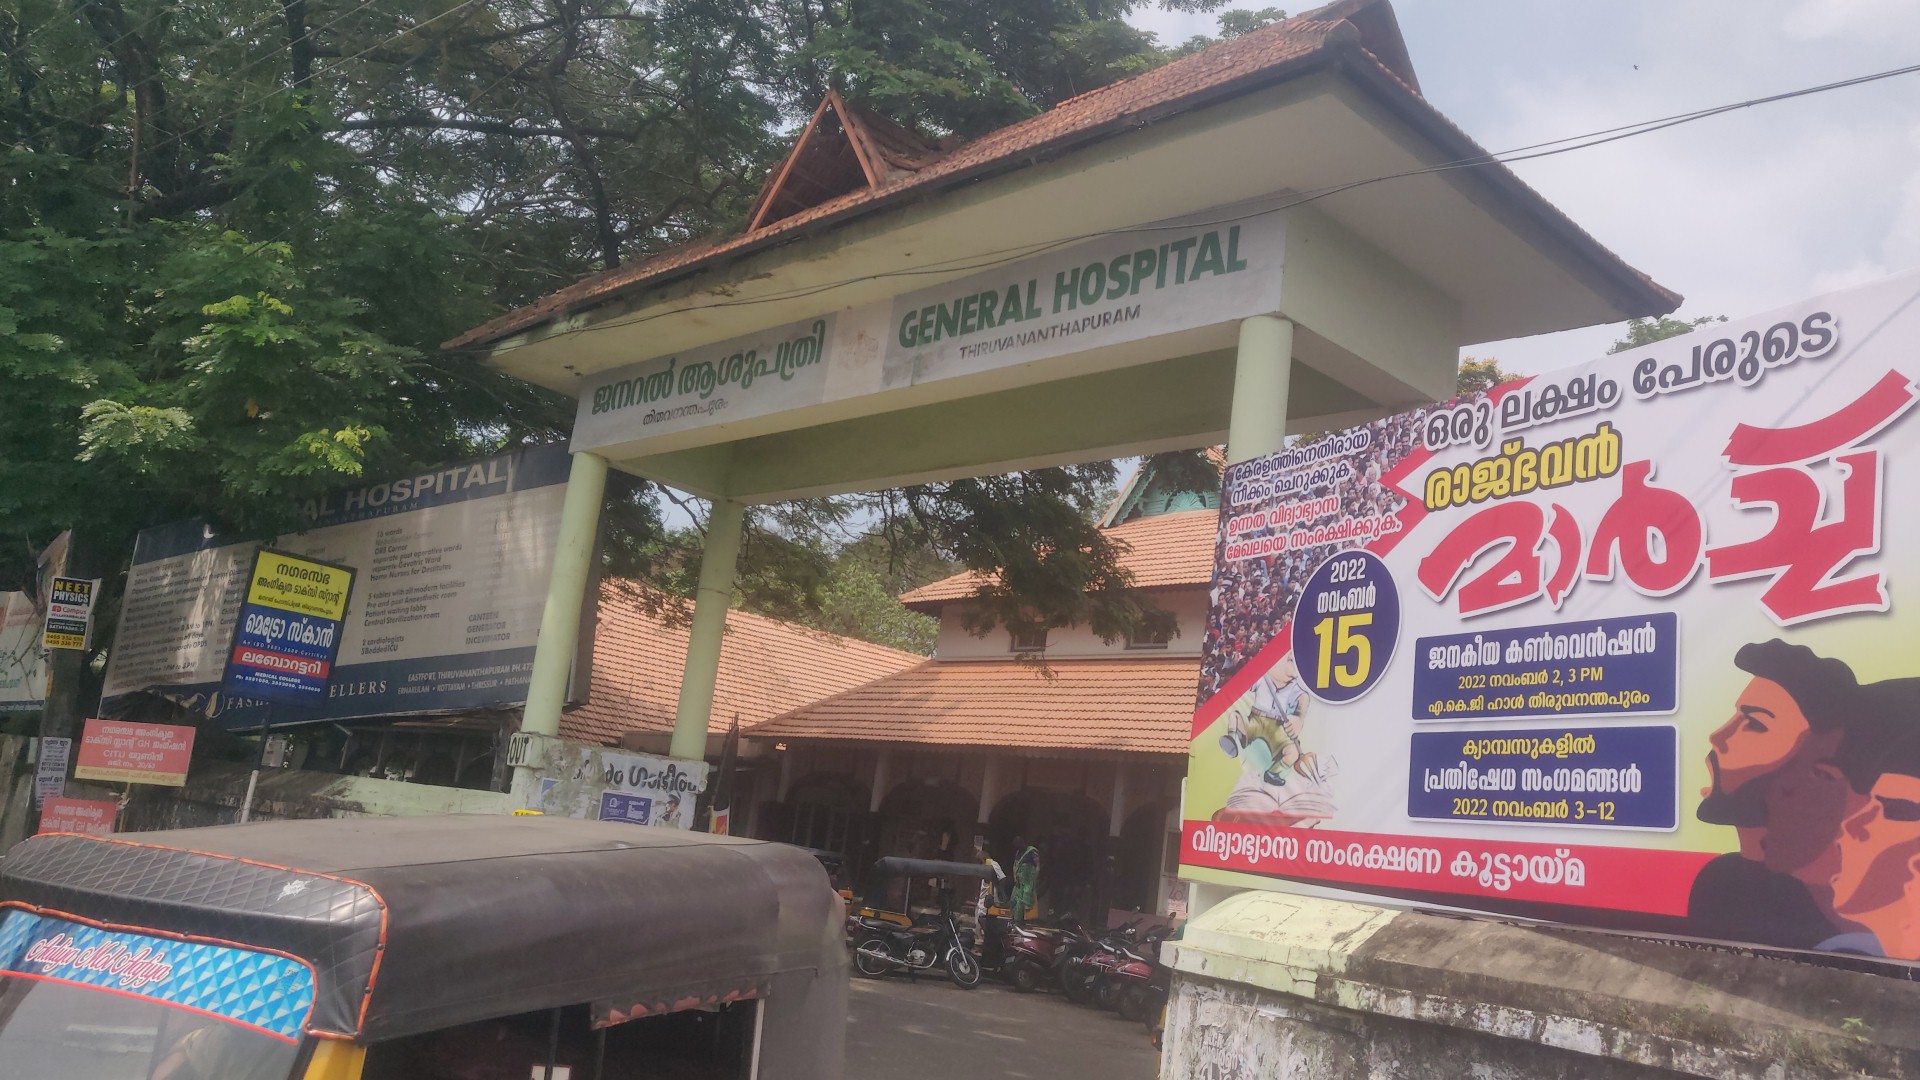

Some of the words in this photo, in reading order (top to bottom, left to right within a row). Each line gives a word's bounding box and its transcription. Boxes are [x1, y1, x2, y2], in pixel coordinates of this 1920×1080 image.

[899, 278, 1042, 349] GENERAL
[1052, 225, 1248, 314] HOSPITAL
[960, 304, 1141, 360] THIRUVANANTHAPURAM
[591, 357, 676, 415] ജനറൽ
[678, 319, 826, 400] ആശുപത്രി
[1427, 400, 1490, 446] ഒരു
[1501, 373, 1618, 429] ലക്ഷം
[1632, 311, 1834, 393] പേരുടെ
[1236, 431, 1369, 481] കേരളത്തിനെതിരായ
[1426, 423, 1621, 510] രാജ്ഭവൻ
[345, 456, 507, 511] HOSPITAL
[1232, 485, 1271, 505] നീക്കം
[1274, 463, 1350, 495] ചെറുക്കുക
[1418, 368, 1911, 621] മാർച്ച്
[1229, 514, 1266, 537] ഉന്നത
[1270, 497, 1340, 527] വിദ്യാഭ്യാസ
[1227, 536, 1287, 560] മേഖലയെ
[1291, 515, 1402, 548] സംരക്ഷിക്കുക.
[276, 563, 330, 585] നഗരസഭ
[1330, 558, 1366, 583] 2022
[53, 590, 89, 603] PHYSICS
[54, 580, 91, 594] NEET
[1317, 581, 1376, 613] നവംബർ
[62, 606, 87, 615] Campus
[410, 604, 426, 612] lobby
[468, 611, 498, 622] CANTEEN
[245, 613, 285, 643] മെട്രോ
[287, 617, 335, 648] സ്കാൻ
[467, 621, 507, 633] GENERATOR
[1313, 613, 1372, 689] 15
[1428, 634, 1500, 670] ജനകീയ
[1505, 622, 1656, 664] കൺവെൻഷൻ
[241, 651, 321, 675] ലബോറട്ടറി
[254, 671, 278, 680] MEDICAL
[279, 675, 301, 684] COLLEGE
[1458, 674, 1487, 690] 2022
[1489, 670, 1548, 687] നവംബർ
[1552, 669, 1564, 687] 2,
[1568, 668, 1577, 682] 3
[1580, 666, 1603, 682] PM
[1428, 695, 1484, 716] എ.കെ.ജി
[1487, 694, 1524, 711] ഹാൾ
[1528, 689, 1650, 711] തിരുവനന്തപുരം
[103, 750, 125, 758] CITU
[138, 740, 150, 748] GH
[510, 736, 530, 764] OUT
[1463, 732, 1596, 760] ക്യാമ്പസുകളിൽ
[1424, 760, 1516, 793] പ്രതിഷേധ
[1521, 763, 1642, 793] സംഗമങ്ങൾ
[1452, 798, 1488, 816] 2022
[1492, 799, 1569, 819] നവംബർ
[1191, 824, 1298, 865] വിദ്യാഭ്യാസ
[1305, 837, 1442, 875] സംരക്ഷണ
[1450, 848, 1586, 891] കൂട്ടായ്മ
